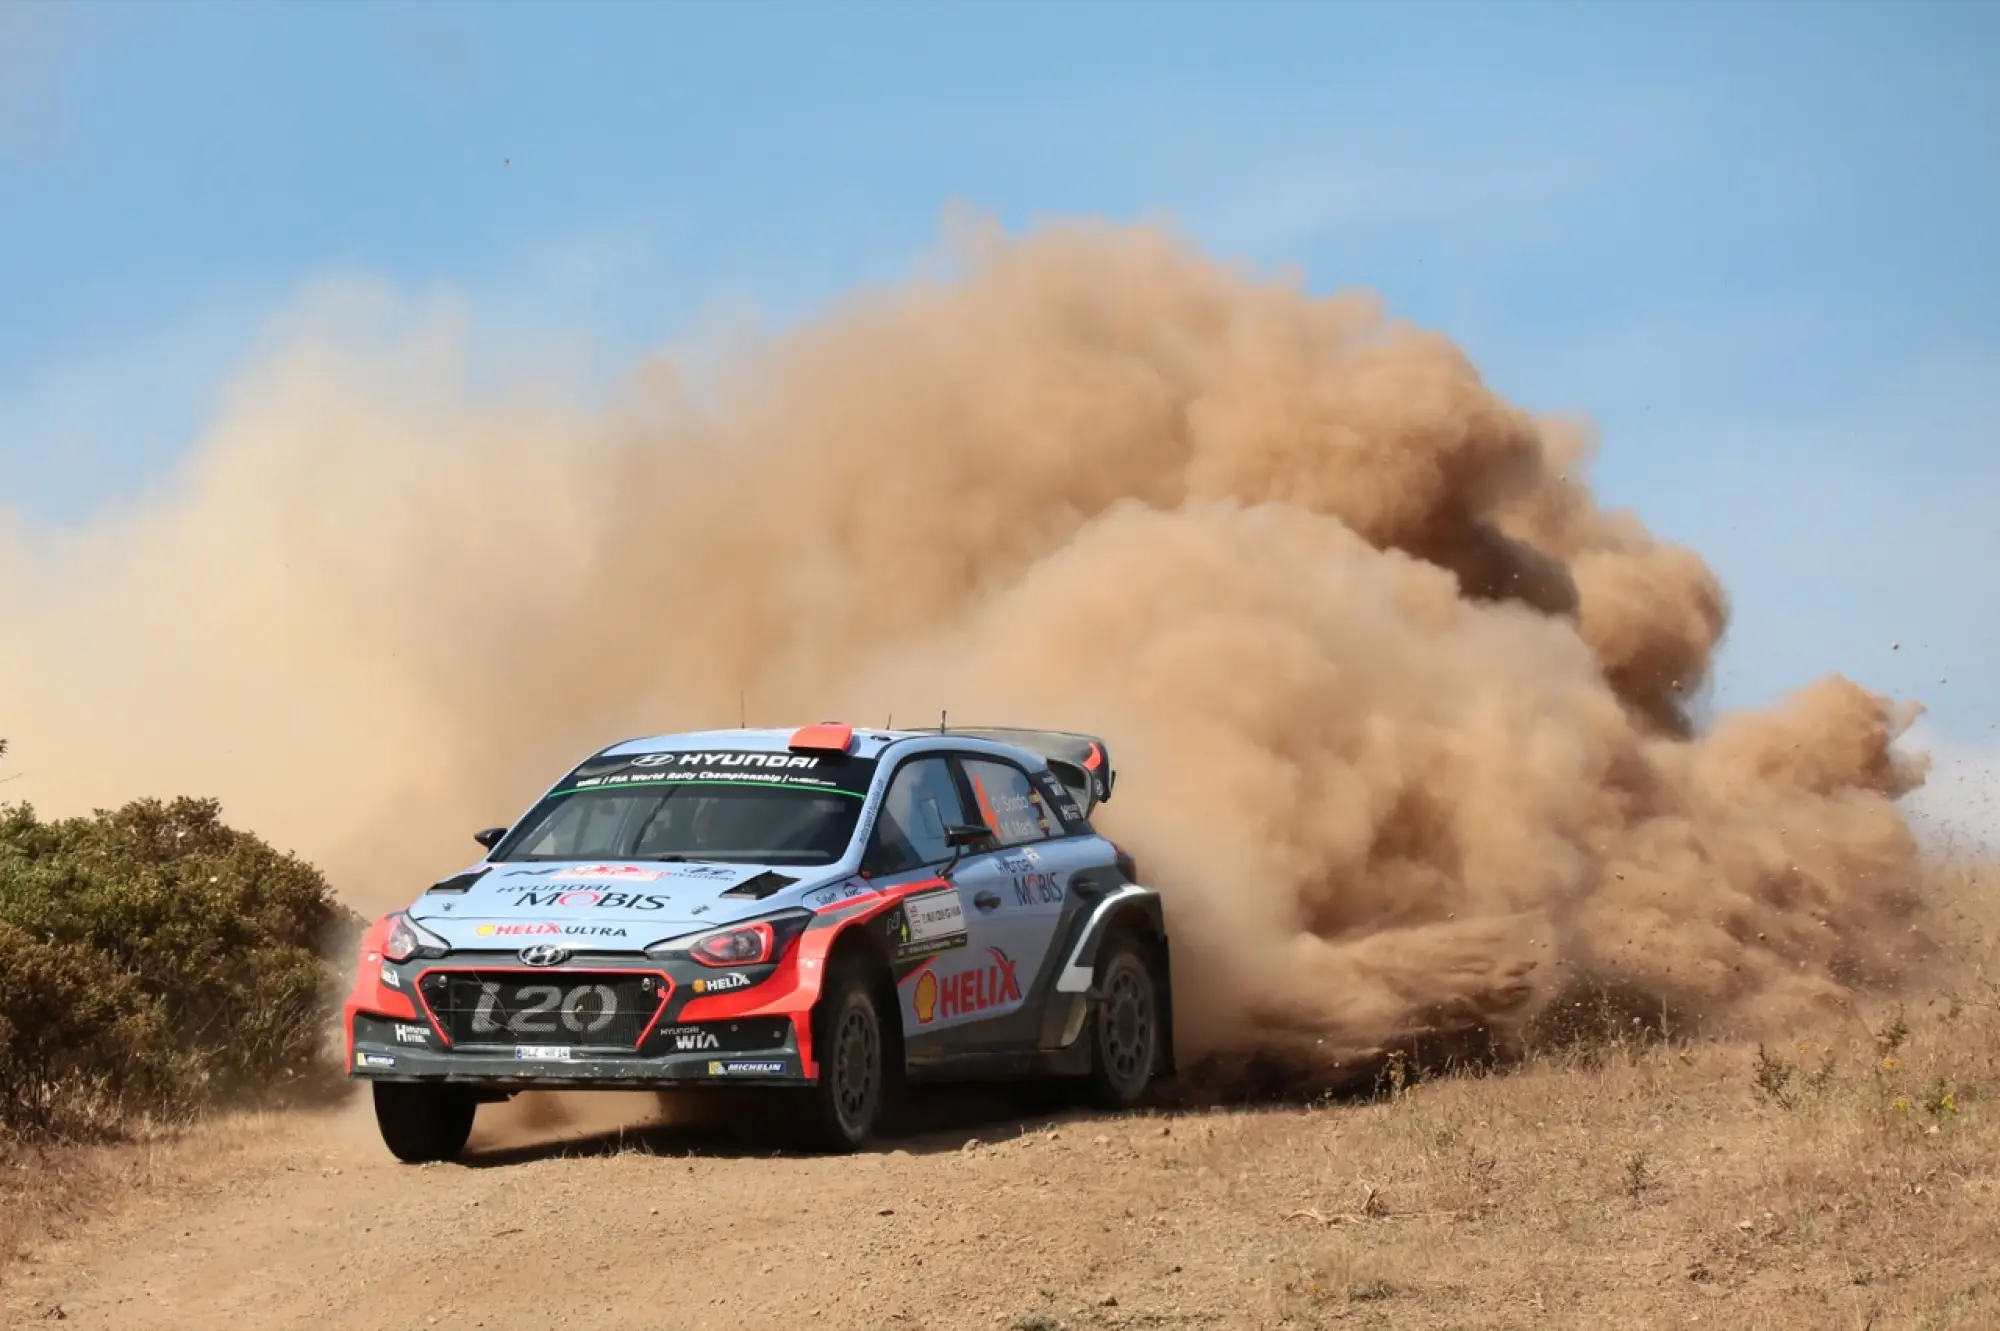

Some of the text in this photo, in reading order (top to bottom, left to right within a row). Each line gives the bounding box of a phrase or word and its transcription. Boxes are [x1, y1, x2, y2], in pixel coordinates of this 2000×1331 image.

[679, 753, 820, 769] HYUNDAI
[608, 774, 629, 784] FIA
[631, 771, 665, 782] World
[667, 771, 698, 781] Rally
[699, 770, 782, 783] Championship
[496, 884, 612, 894] HYUNDAI
[1013, 872, 1063, 907] MOBIS
[513, 891, 671, 911] MOBIS
[495, 922, 628, 938] HELIX ULTRA
[706, 972, 751, 991] HELIX
[940, 948, 1022, 1019] HELIX
[660, 1026, 700, 1036] HYUNDAI
[727, 1063, 782, 1072] MICHELIN
